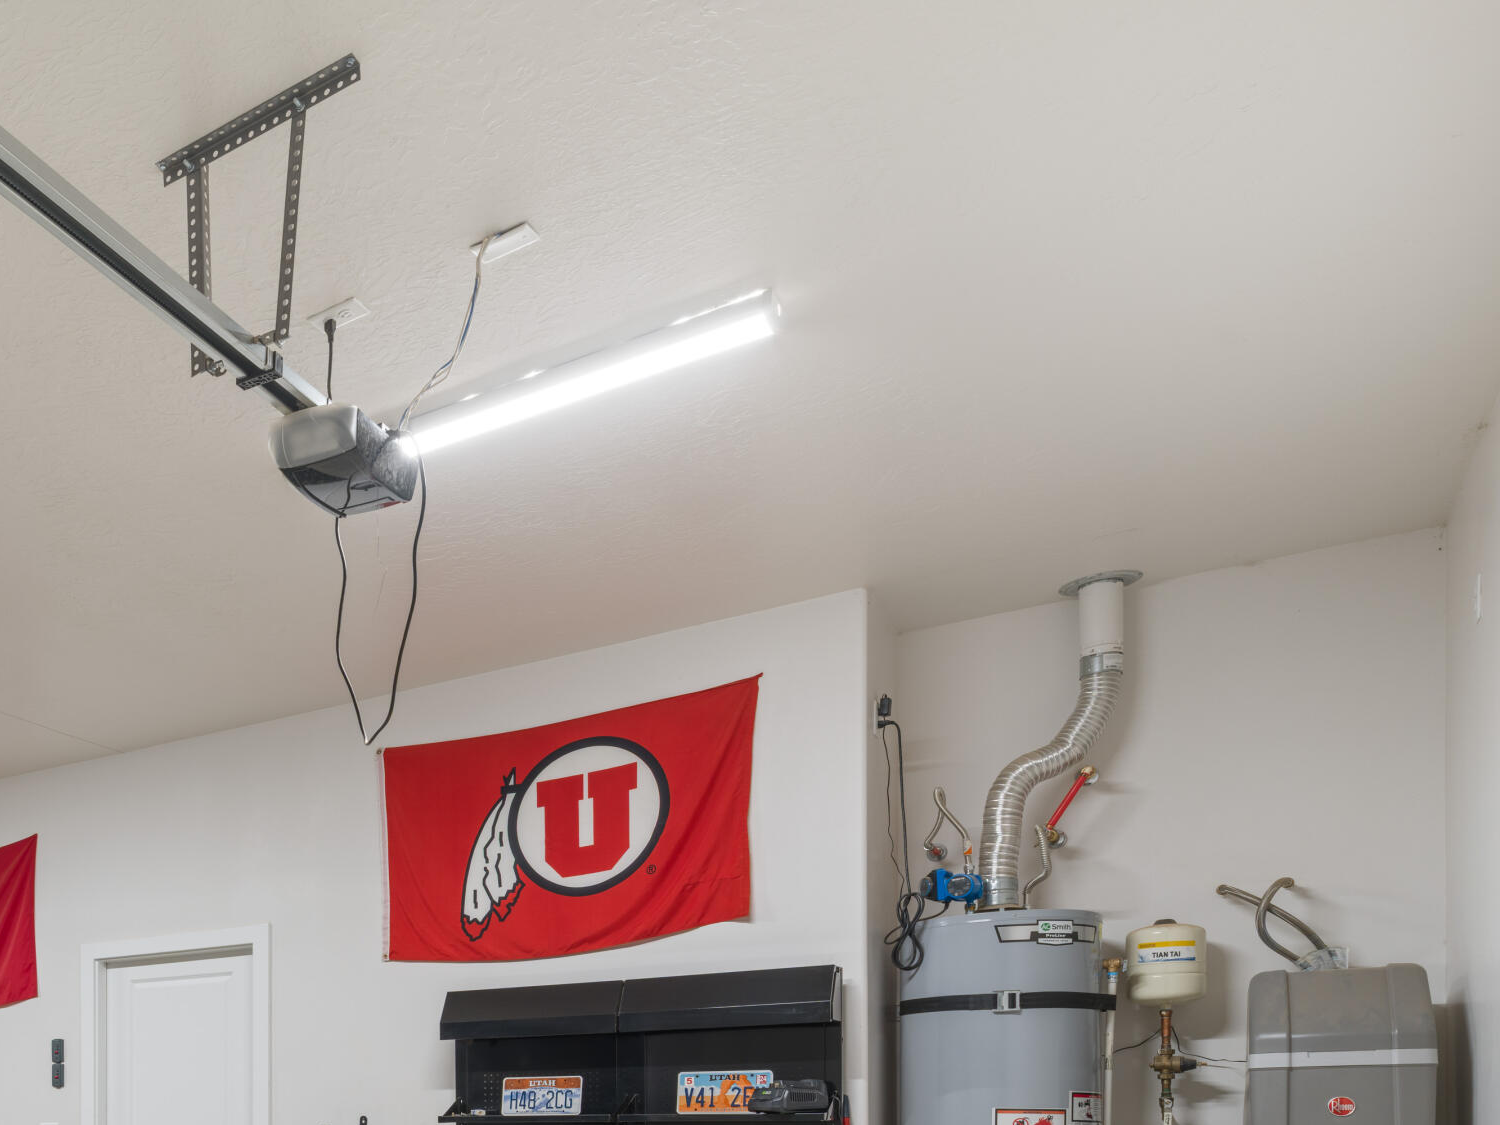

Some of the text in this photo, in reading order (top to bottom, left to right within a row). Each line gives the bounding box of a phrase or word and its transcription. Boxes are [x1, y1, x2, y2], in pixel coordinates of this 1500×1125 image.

[536, 761, 638, 878] U
[1051, 923, 1072, 931] Smith
[529, 1079, 556, 1087] UTAH
[686, 1077, 693, 1085] 5
[545, 1090, 573, 1109] 2CG
[684, 1087, 715, 1108] V41
